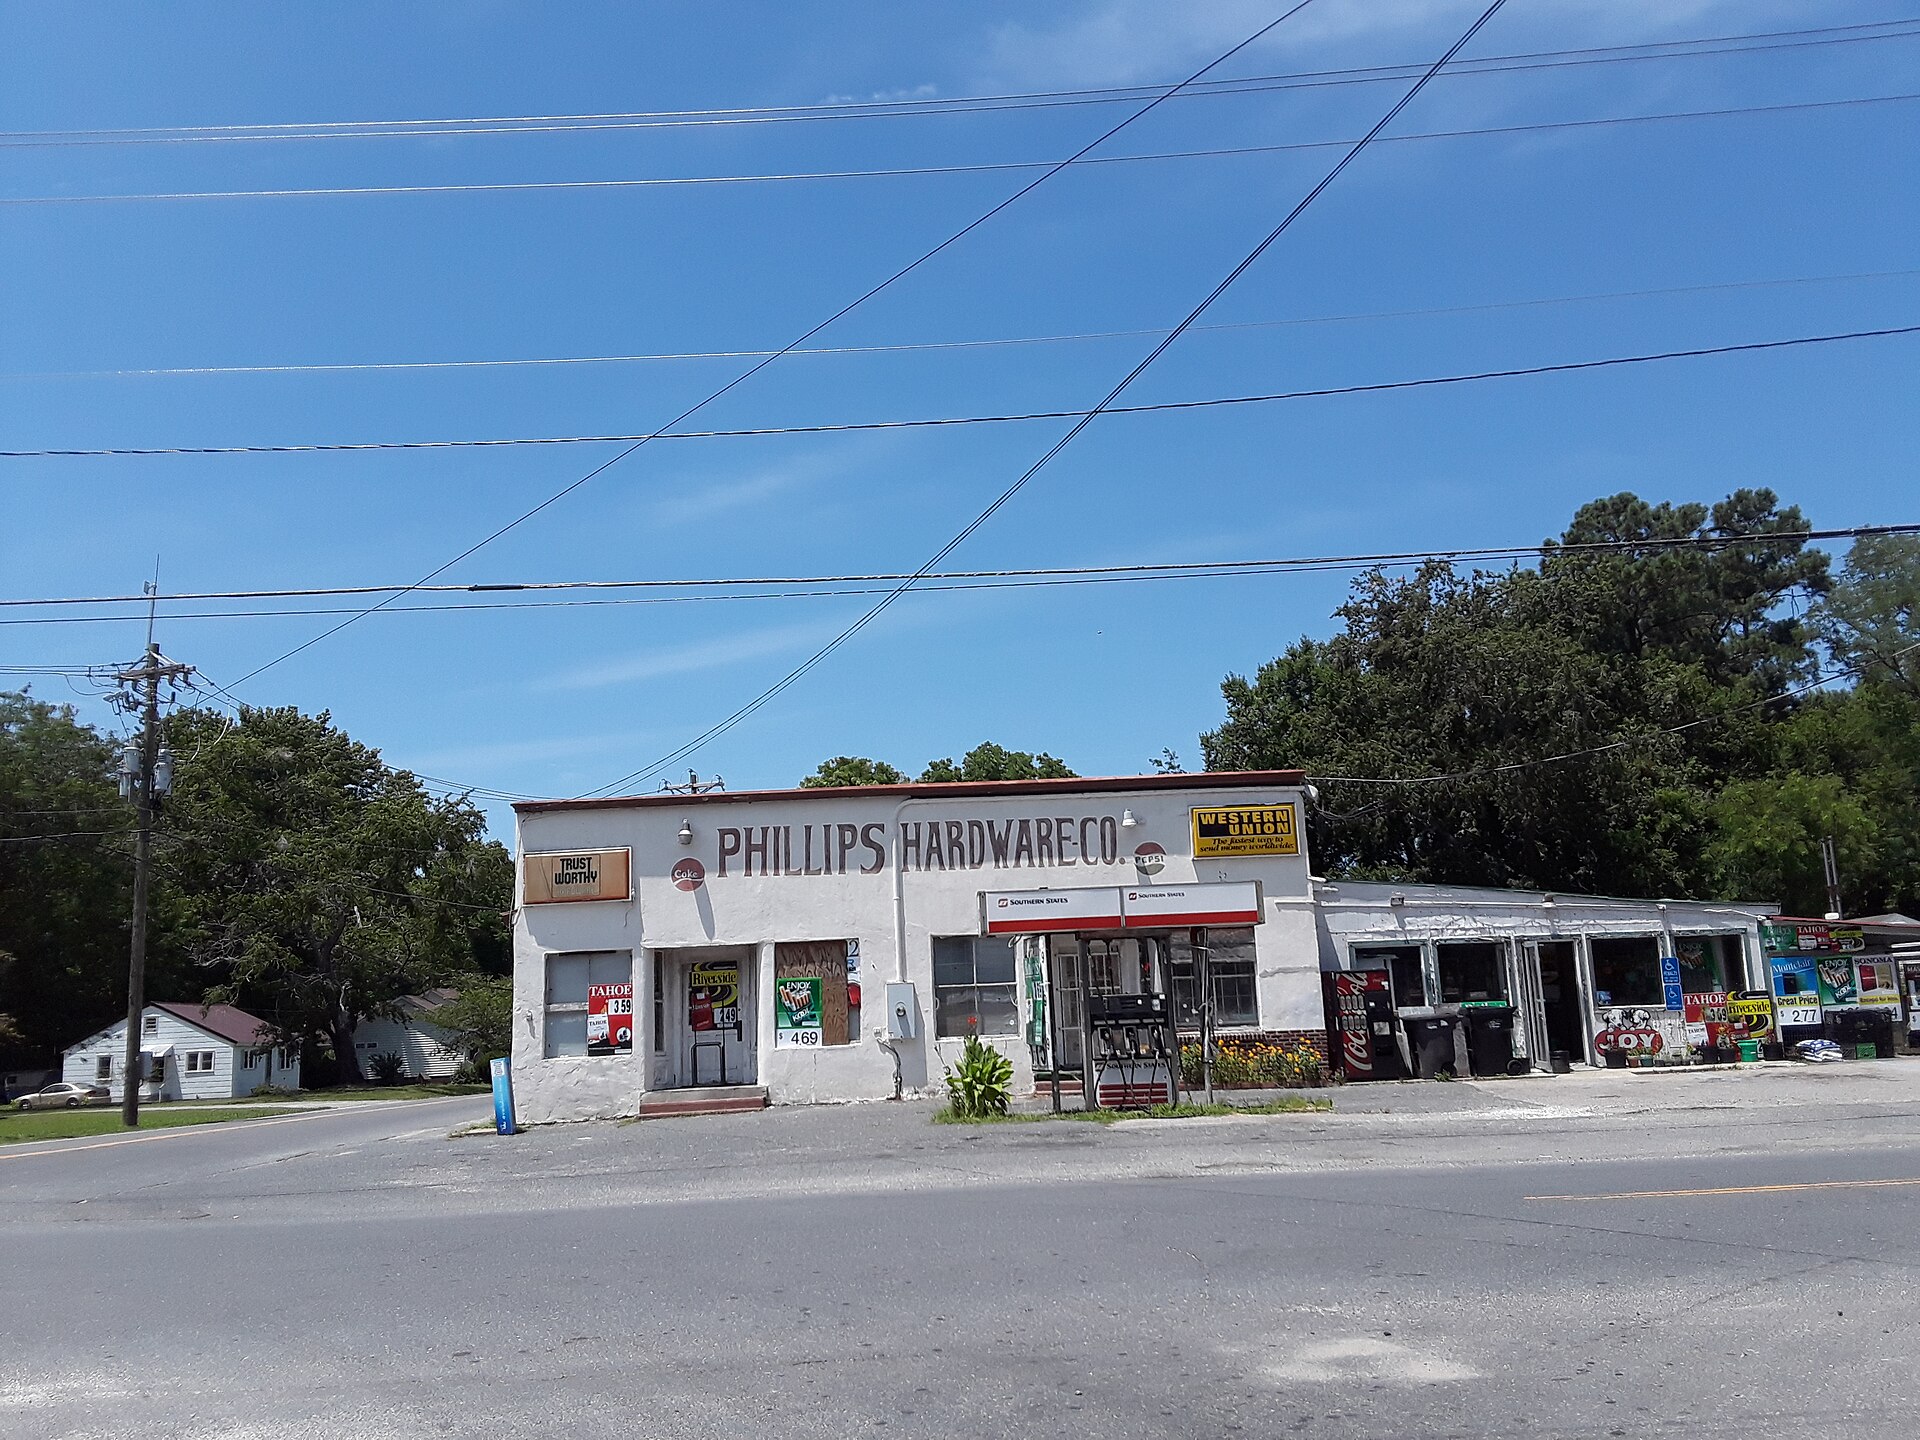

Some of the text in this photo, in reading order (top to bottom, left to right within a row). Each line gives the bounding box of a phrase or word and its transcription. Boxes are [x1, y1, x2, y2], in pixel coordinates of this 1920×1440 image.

[1200, 810, 1288, 825] WESTERN
[1229, 822, 1289, 835] UNION
[1229, 837, 1255, 845] fastest
[717, 822, 886, 878] PHILLIPS
[1200, 844, 1219, 852] send
[1221, 844, 1245, 852] money
[559, 856, 593, 871] TRUST
[1135, 855, 1164, 864] PEPSI
[554, 871, 598, 885] WORTHY
[674, 869, 699, 879] Coke
[1797, 925, 1828, 934] TAHOE
[1772, 959, 1812, 974] Montclair
[1854, 956, 1893, 965] SONOMA
[693, 971, 737, 985] Riverside
[588, 985, 632, 997] TAHOE
[1834, 984, 1851, 999] KOOL
[1684, 993, 1726, 1005] TAHOE
[1777, 996, 1818, 1006] Great Price
[792, 1009, 810, 1023] KOOL
[1598, 1033, 1656, 1051] JOY
